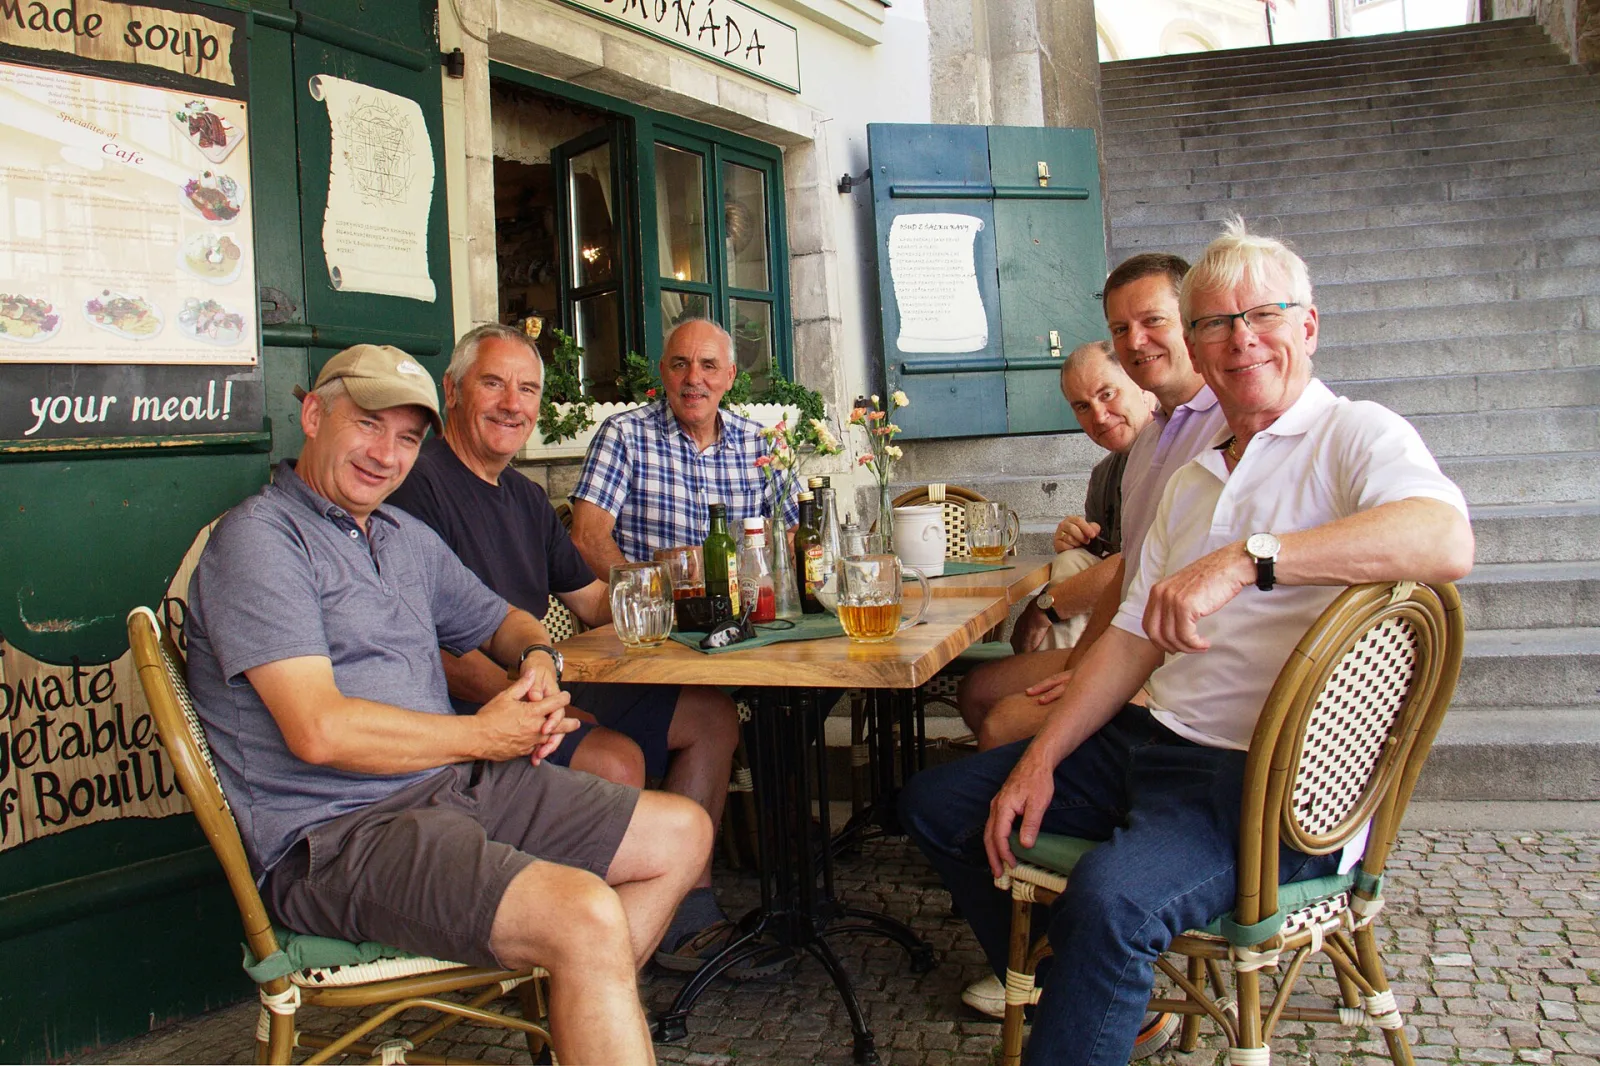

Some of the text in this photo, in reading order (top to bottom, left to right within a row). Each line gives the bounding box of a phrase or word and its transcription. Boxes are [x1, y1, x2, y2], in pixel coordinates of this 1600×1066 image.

[123, 19, 220, 75] soup
[101, 142, 145, 165] Cafe
[24, 379, 233, 437] your meal!
